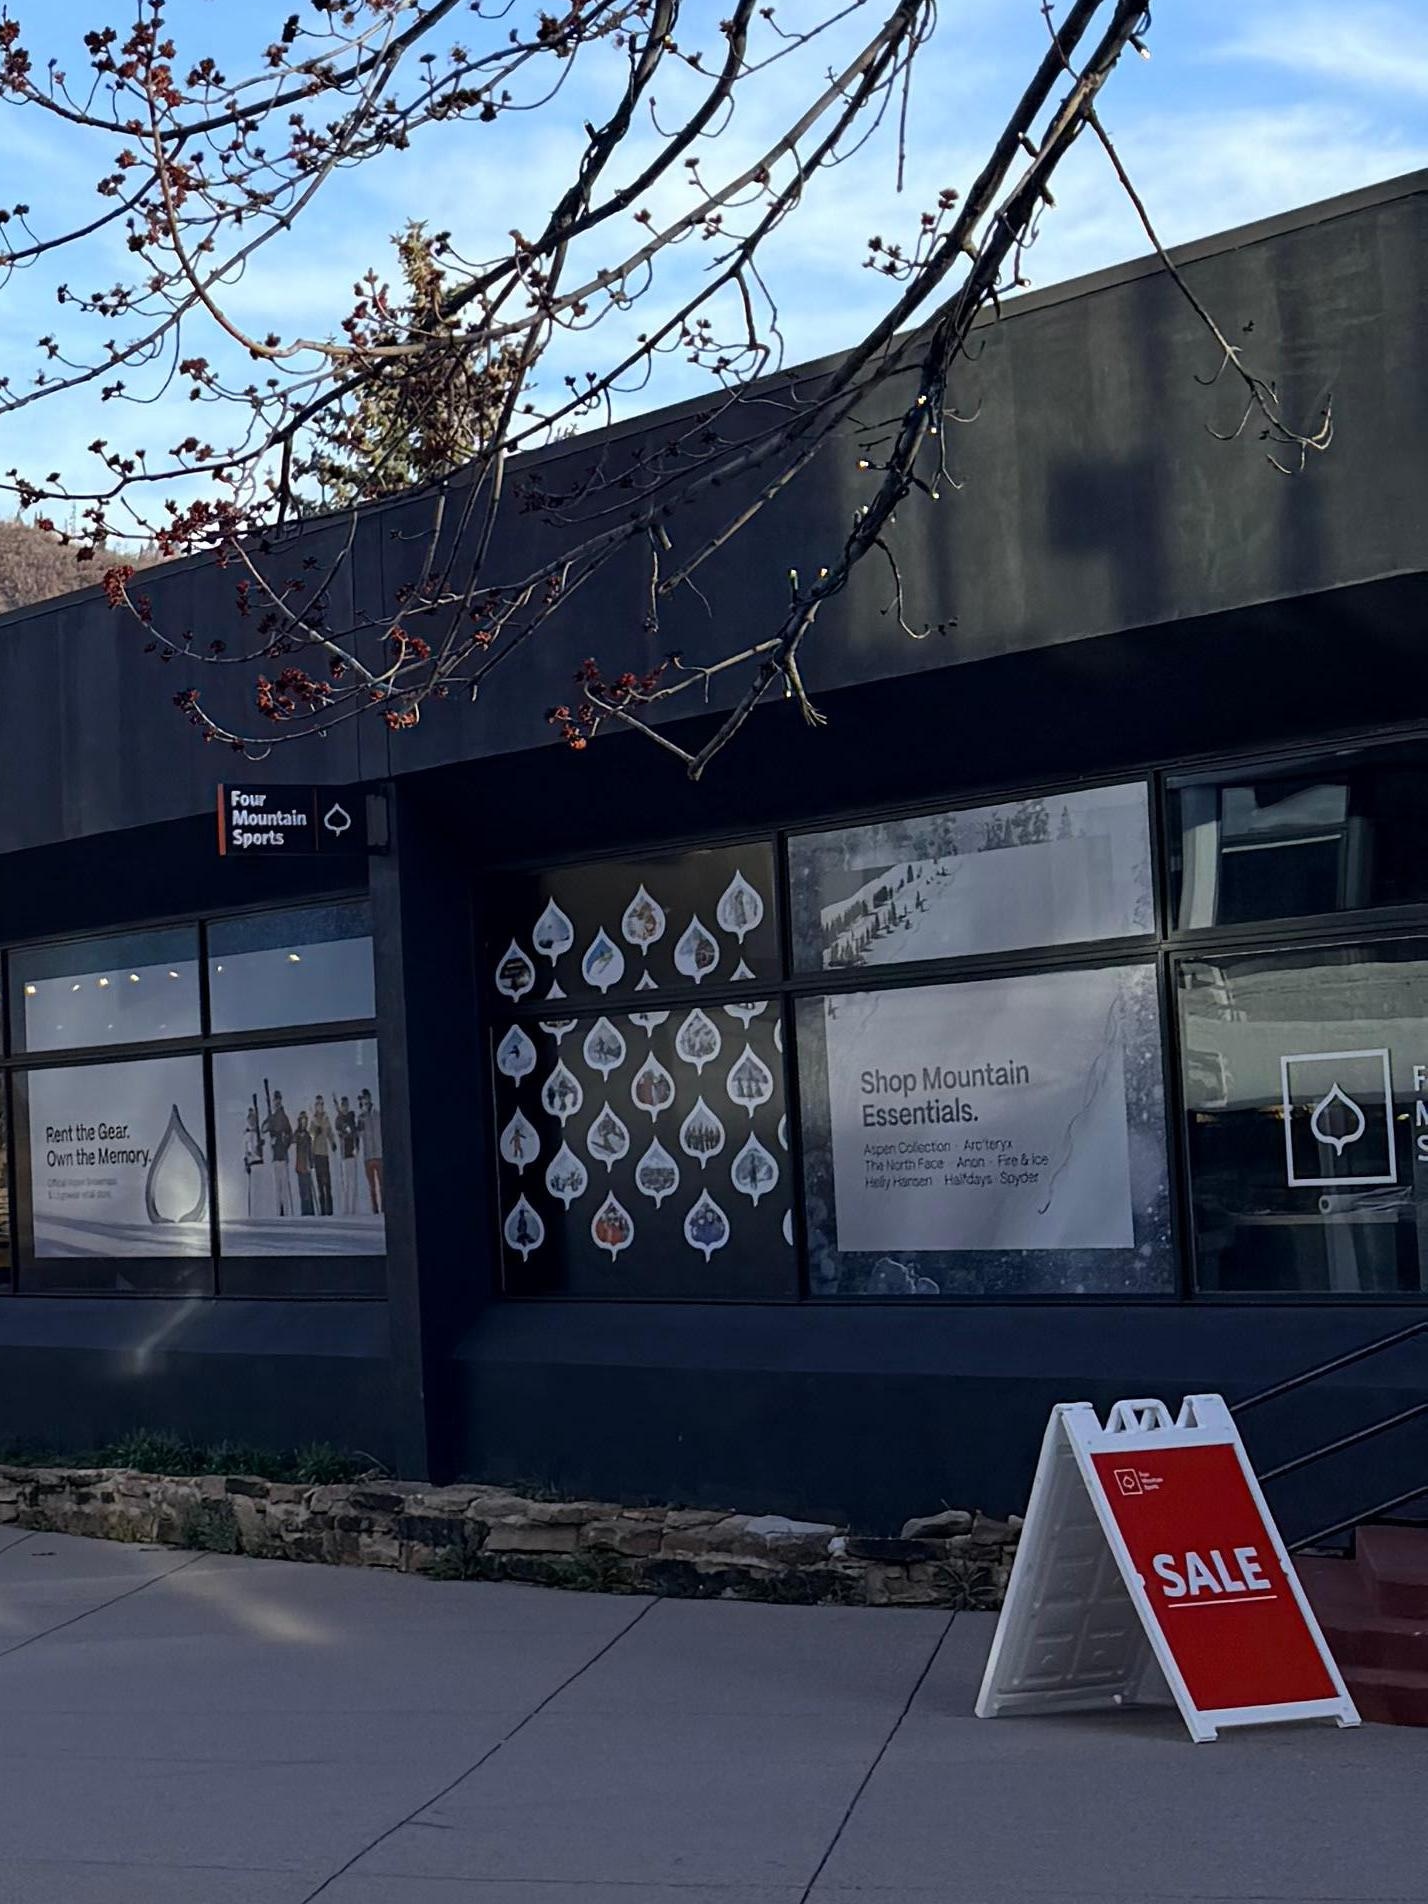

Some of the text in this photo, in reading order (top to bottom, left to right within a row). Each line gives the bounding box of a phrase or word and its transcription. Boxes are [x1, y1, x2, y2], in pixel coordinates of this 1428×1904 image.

[230, 790, 267, 807] Four
[231, 809, 307, 826] Mountain
[231, 829, 285, 849] Sports
[860, 1059, 1030, 1098] Shop Mountain
[862, 1097, 979, 1128] Essentials.
[76, 1123, 96, 1142] the
[97, 1122, 131, 1140] Gear.
[46, 1147, 153, 1168] Own the Memory.
[898, 1140, 952, 1155] Collection
[885, 1158, 916, 1171] North
[917, 1157, 945, 1170] Face
[1152, 1546, 1272, 1597] SALE
